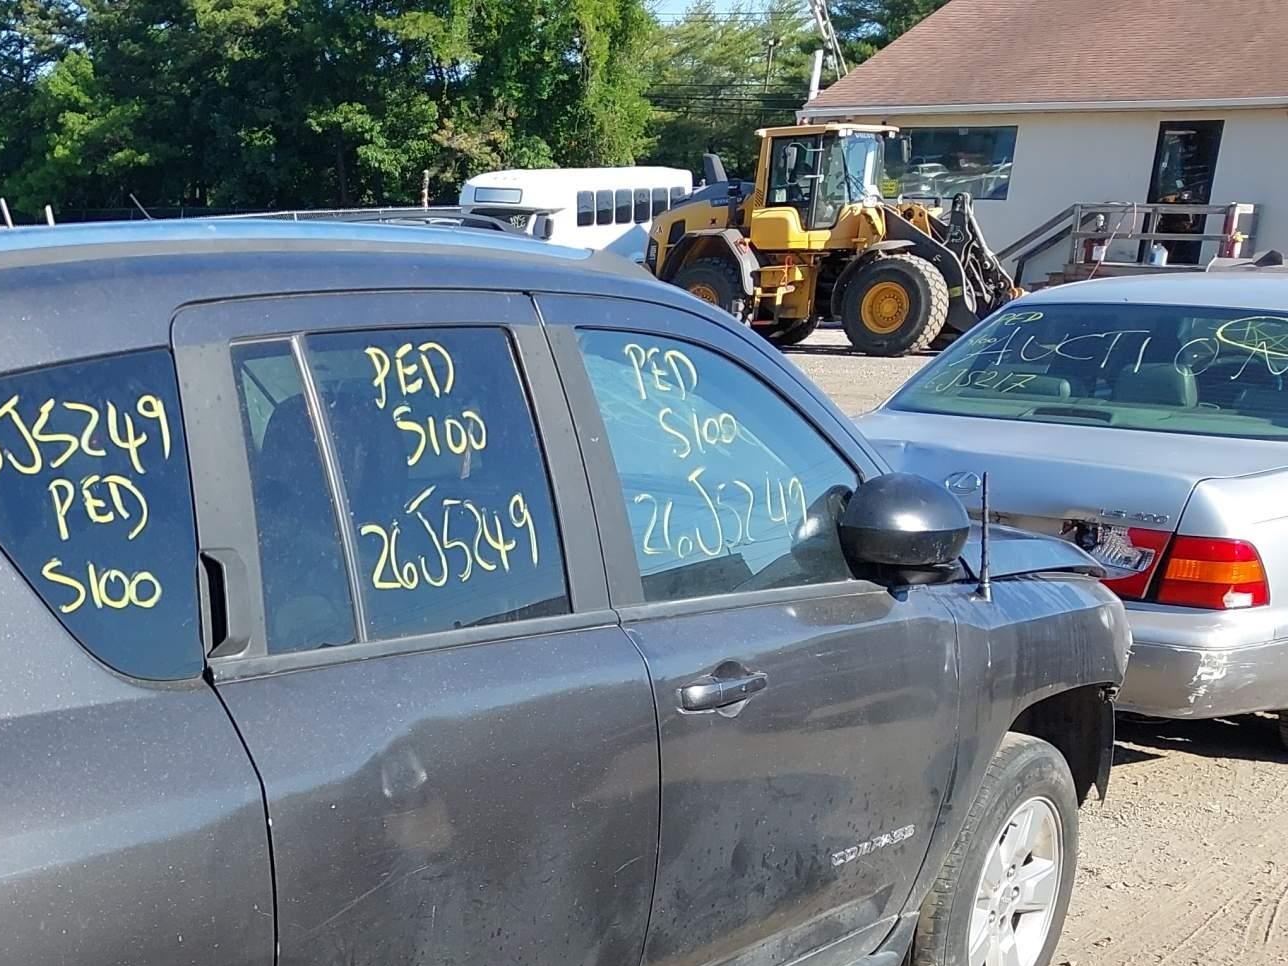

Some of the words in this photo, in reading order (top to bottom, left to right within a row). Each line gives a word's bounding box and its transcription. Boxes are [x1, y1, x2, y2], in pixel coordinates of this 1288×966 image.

[364, 342, 455, 409] PED
[624, 343, 698, 401] PED
[392, 404, 487, 466] S100
[659, 407, 737, 458] S100
[48, 474, 149, 540] PED
[361, 484, 538, 589] 26J5249
[634, 466, 808, 558] 26J5249
[41, 557, 162, 613] S100
